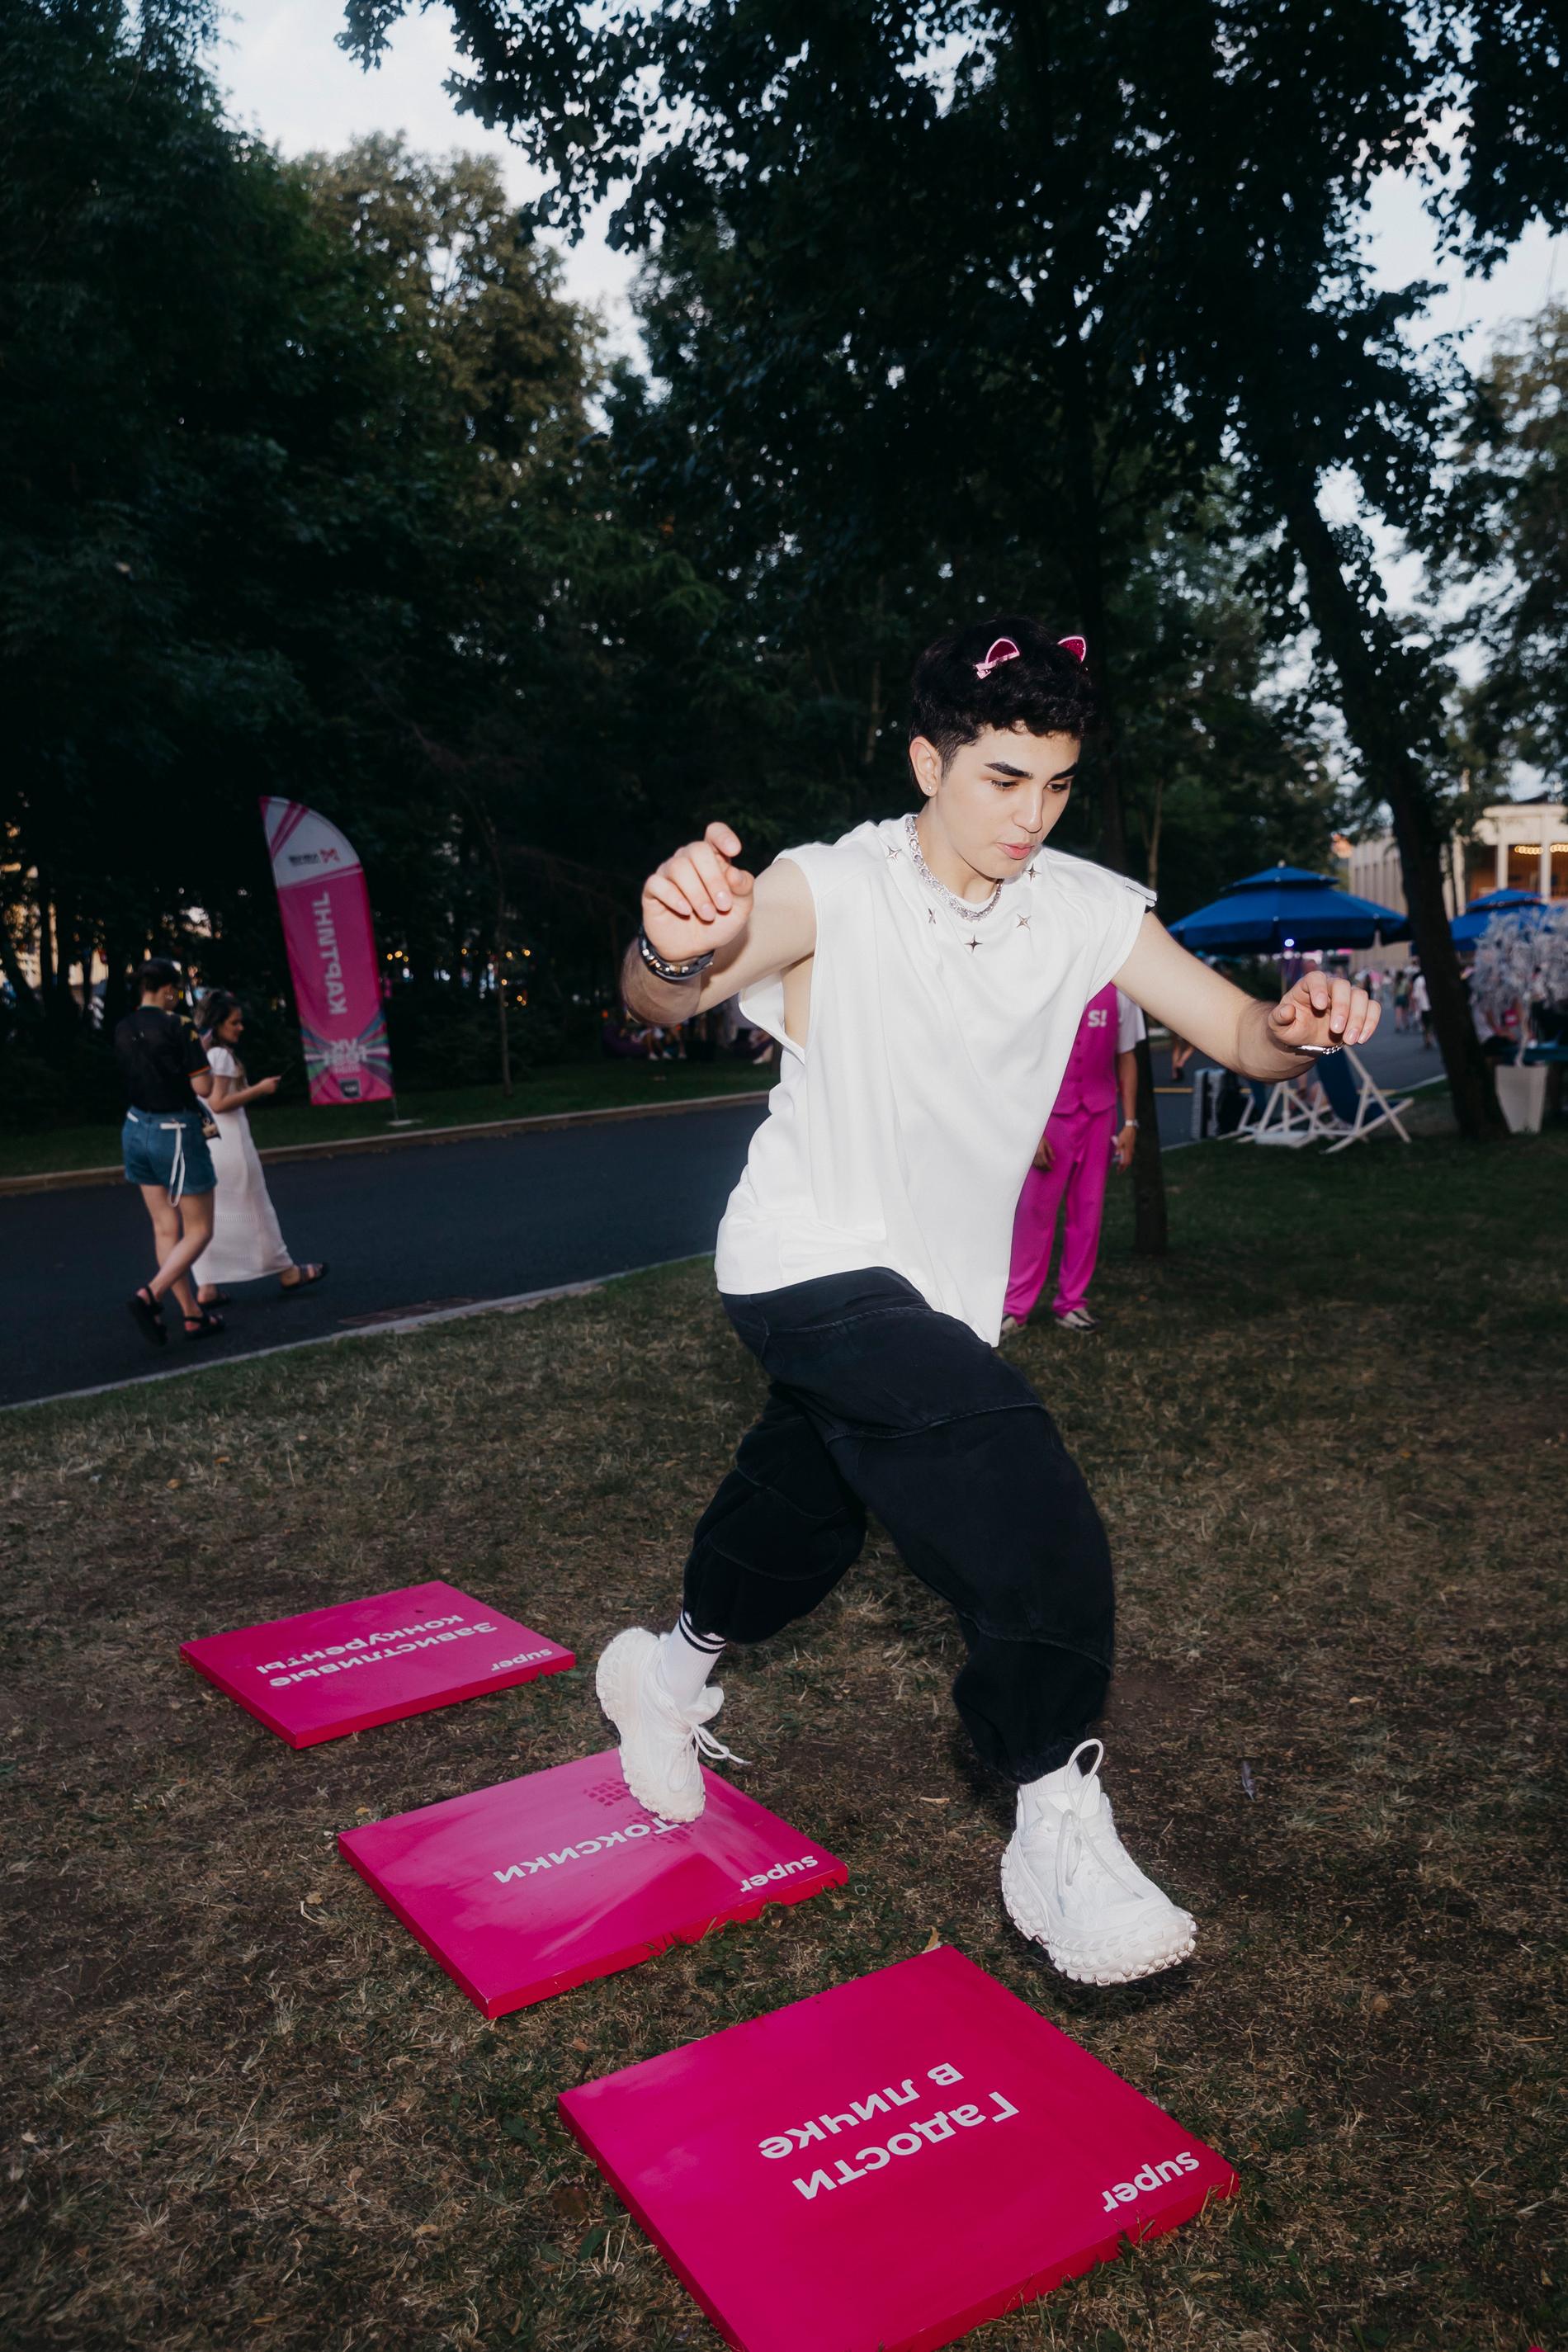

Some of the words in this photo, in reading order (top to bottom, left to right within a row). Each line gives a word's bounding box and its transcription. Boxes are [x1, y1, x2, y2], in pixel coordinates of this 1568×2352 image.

[1088, 1010, 1108, 1028] S!
[257, 1615, 463, 1674] конкуренты
[271, 1622, 498, 1687] Завистливые
[491, 1649, 552, 1671] super
[493, 1817, 679, 1883] Токсики
[740, 1855, 819, 1892] super
[927, 2063, 964, 2085] в
[758, 2079, 920, 2159] личке
[792, 2091, 1019, 2199] Гадости
[1103, 2151, 1200, 2213] super
